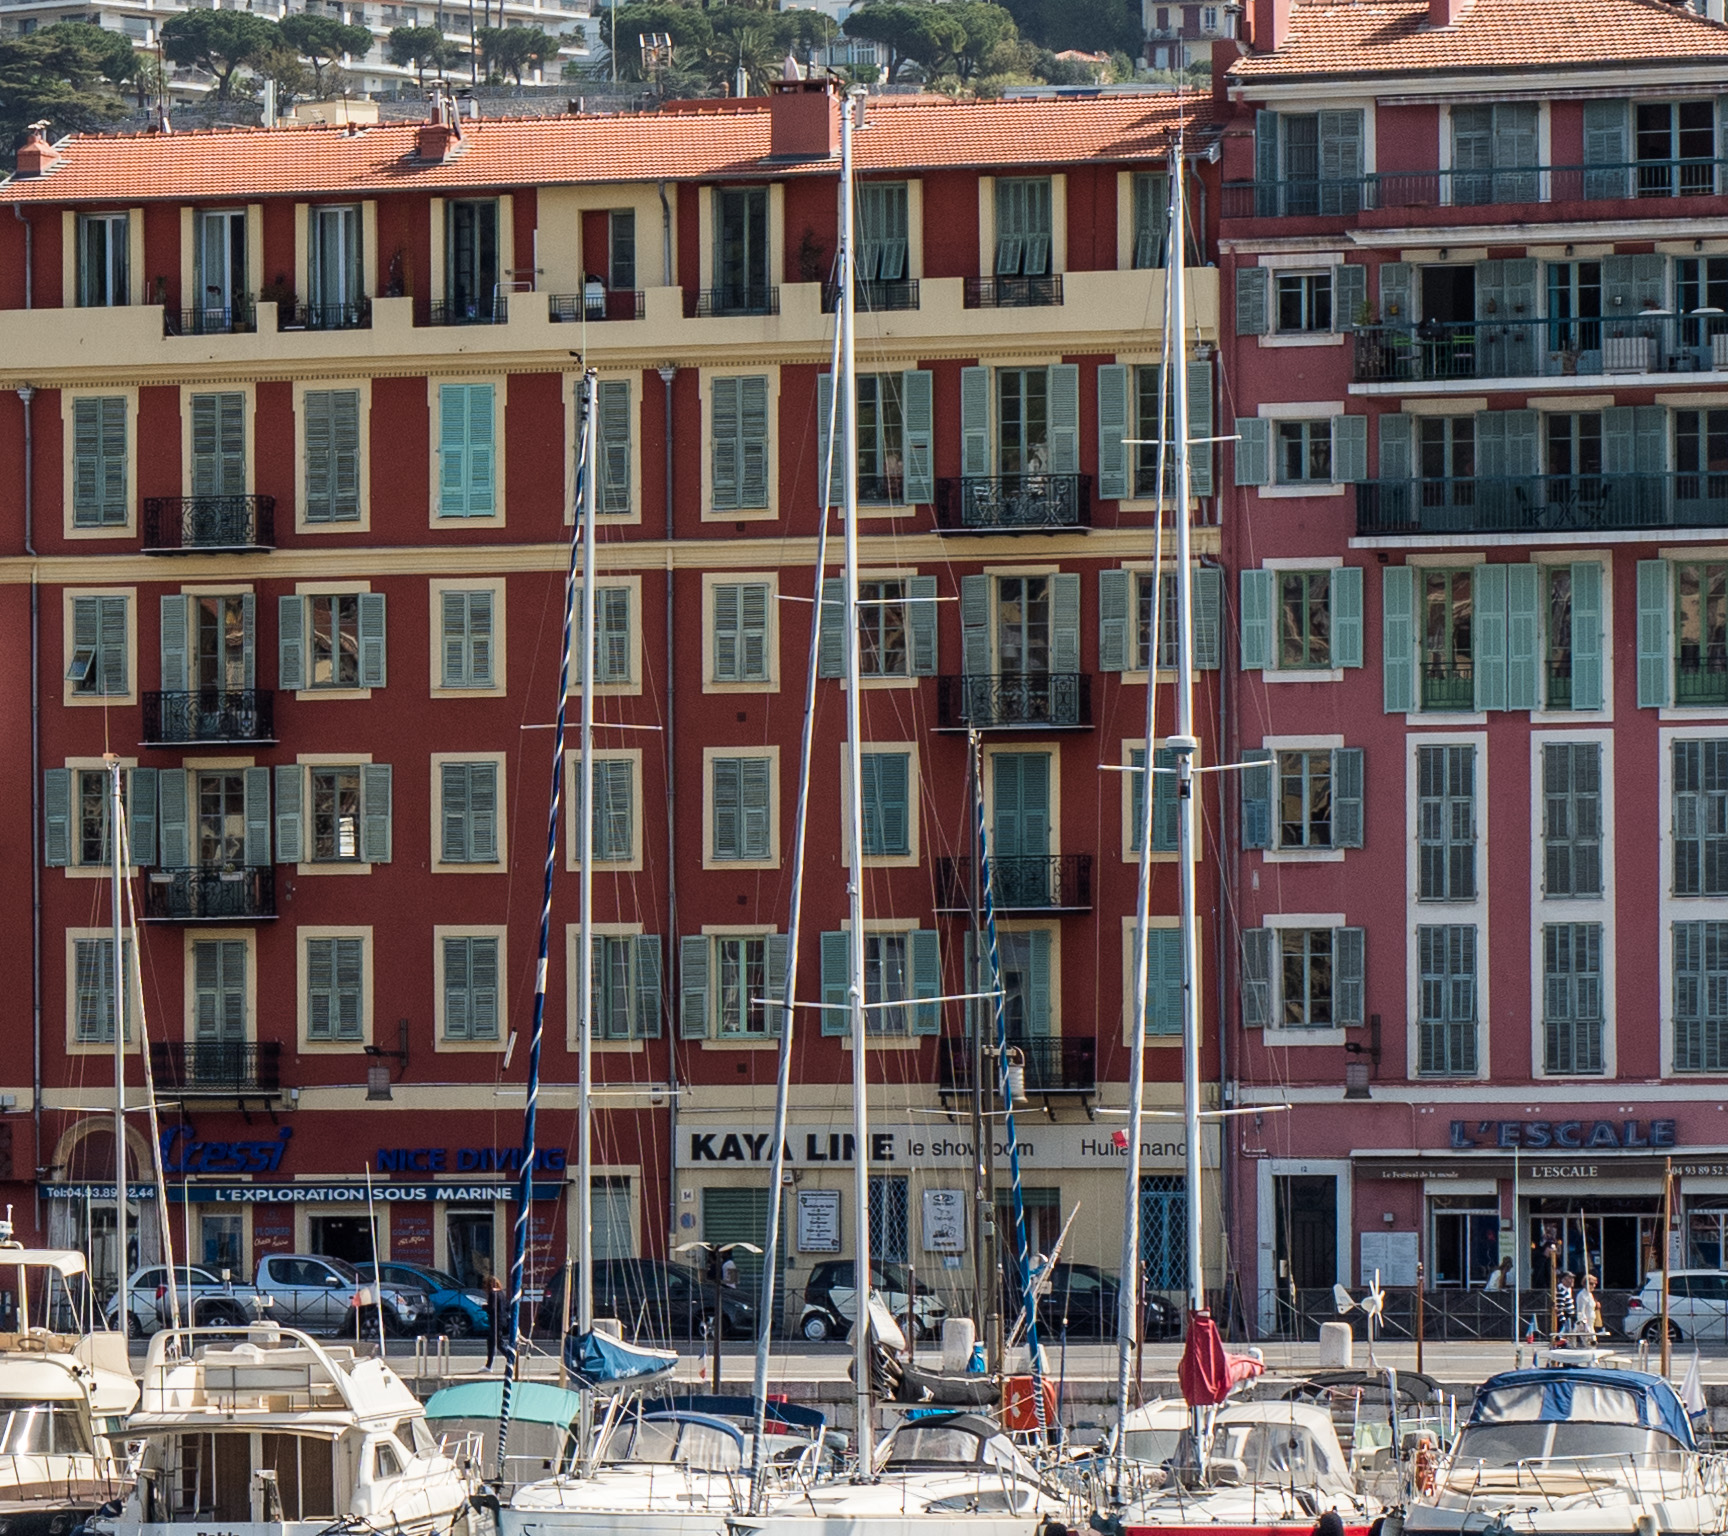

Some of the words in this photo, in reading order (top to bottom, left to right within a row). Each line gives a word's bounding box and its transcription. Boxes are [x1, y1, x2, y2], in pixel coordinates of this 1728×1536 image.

[1450, 1119, 1676, 1149] L'ESCALE
[908, 1139, 925, 1156] le
[377, 1148, 446, 1171] NICE
[1532, 1166, 1598, 1178] L'ESCALE
[215, 1188, 365, 1202] L'EXPLORATION
[373, 1187, 427, 1201] SOUS
[436, 1187, 512, 1201] MARINE
